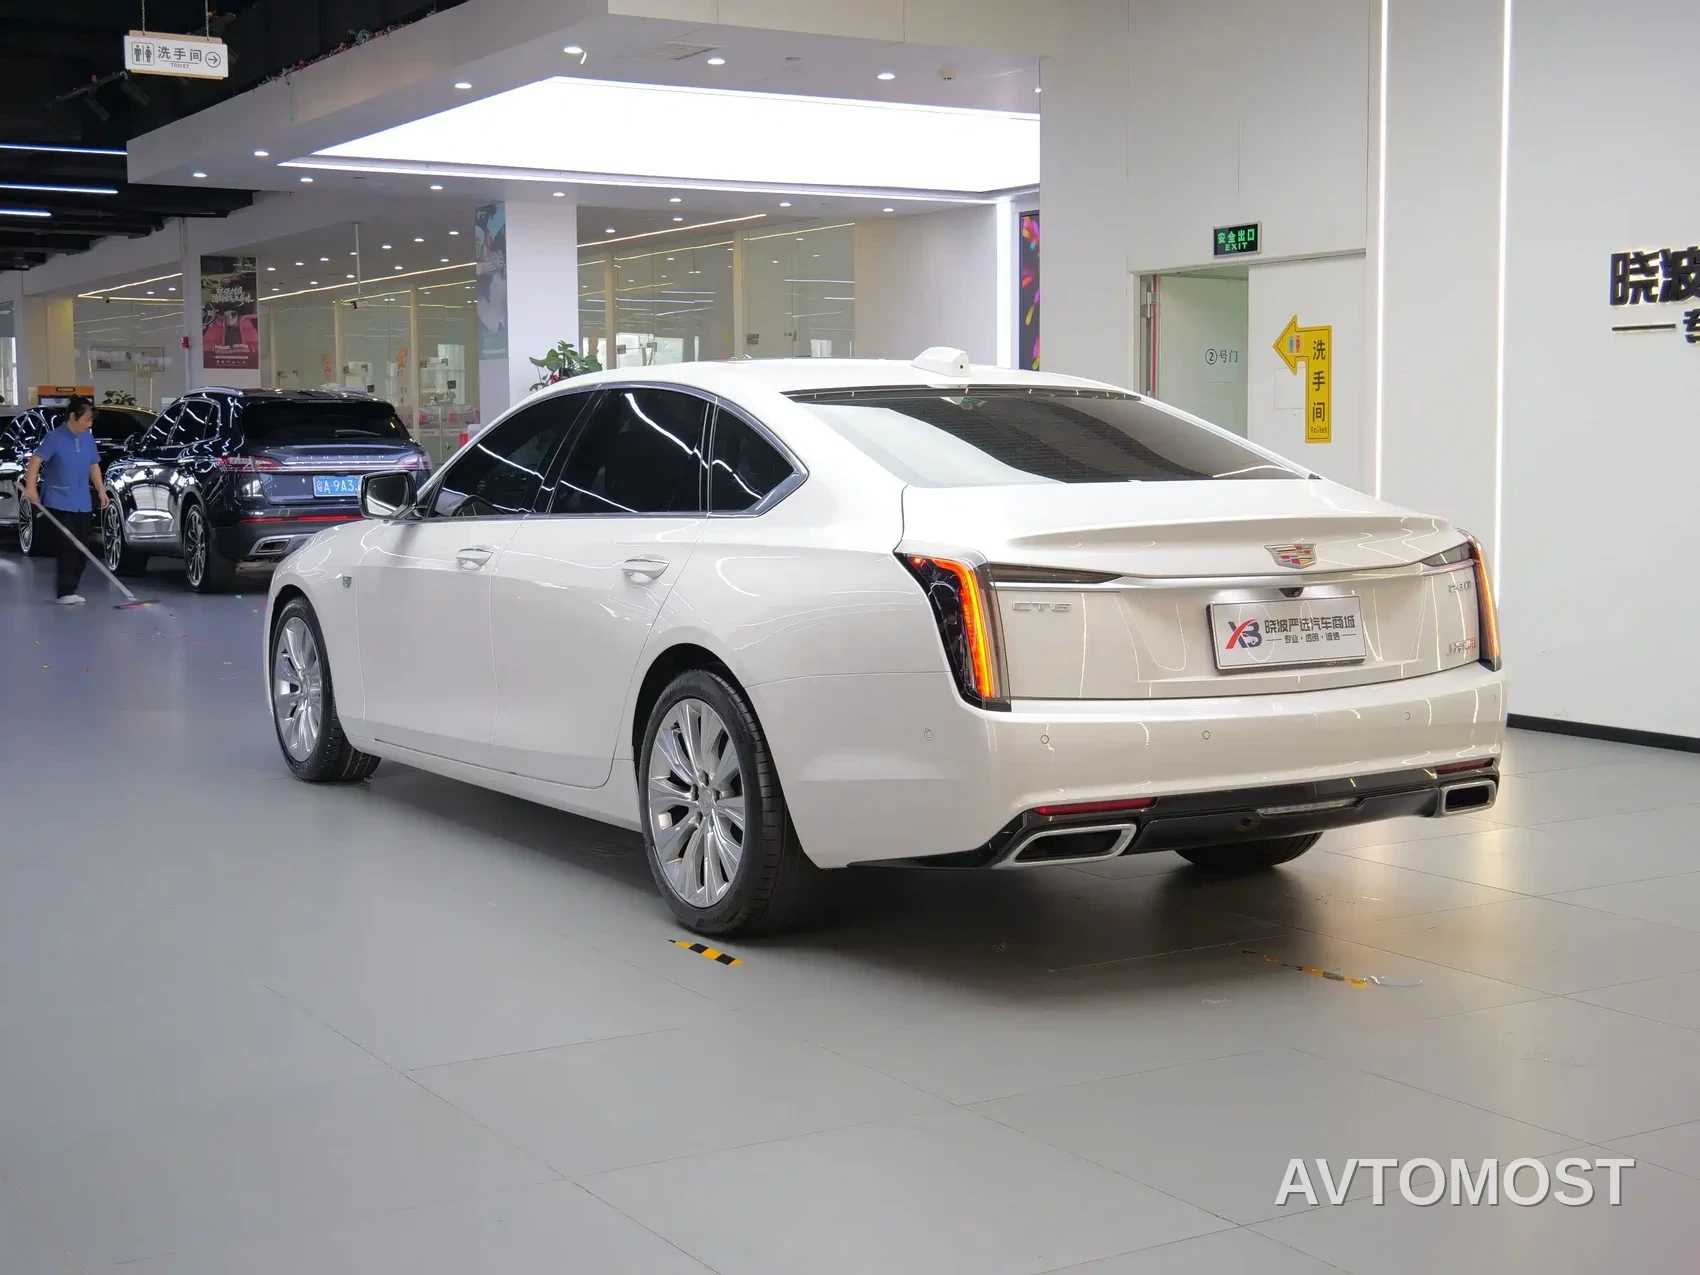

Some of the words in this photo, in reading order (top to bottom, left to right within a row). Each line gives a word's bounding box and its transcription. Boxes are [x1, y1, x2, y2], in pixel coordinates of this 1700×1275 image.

[158, 45, 202, 62] 洗手间
[1218, 228, 1255, 244] 安全出口
[1225, 242, 1247, 251] EXIT
[1312, 340, 1326, 422] 洗手间
[1310, 426, 1328, 434] Toilet
[1012, 601, 1071, 612] CT6
[1264, 615, 1356, 634] 晓波严选汽车商城
